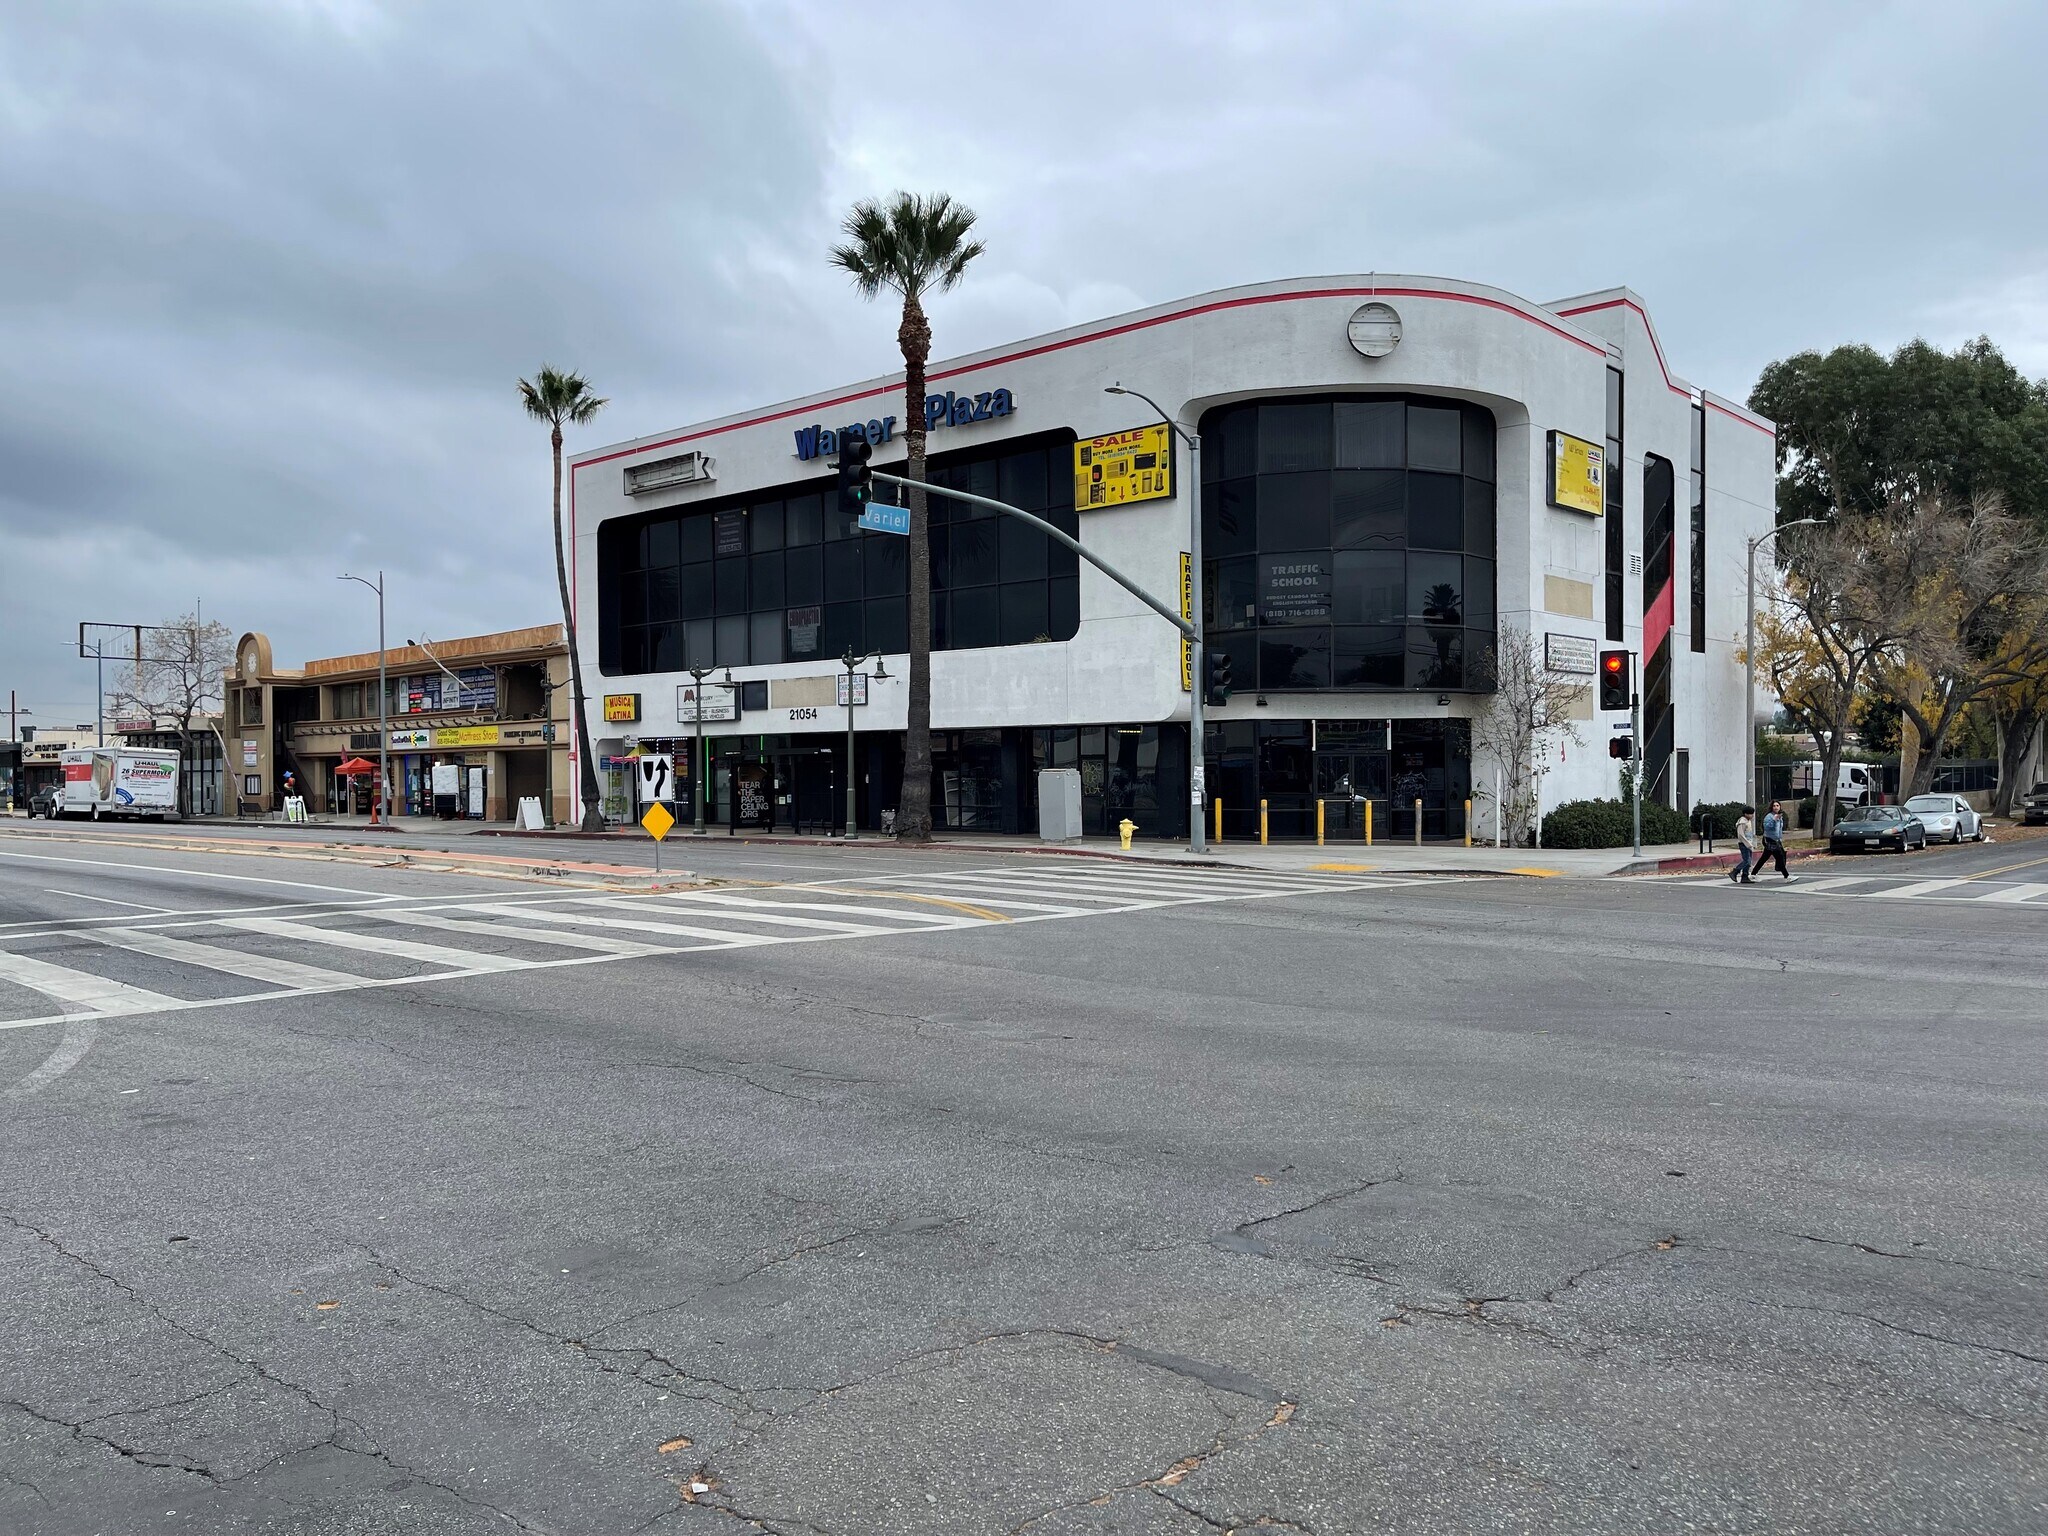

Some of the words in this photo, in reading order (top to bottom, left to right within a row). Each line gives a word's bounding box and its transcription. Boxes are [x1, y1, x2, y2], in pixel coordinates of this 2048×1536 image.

[926, 388, 1014, 431] Plaza
[1092, 430, 1144, 449] SALE
[865, 509, 906, 528] Variel
[1271, 564, 1319, 575] TRAFFIC
[1184, 555, 1192, 620] TRAFFIC
[1271, 577, 1319, 587] SCHOOL
[1265, 609, 1286, 618] (818)
[1288, 608, 1326, 616] 716-0188
[1184, 637, 1192, 681] HOOL
[609, 697, 631, 708] MUSICA
[608, 710, 631, 720] LATINA
[789, 708, 817, 720] 21054
[437, 729, 448, 737] Good
[459, 732, 481, 742] Mattress
[482, 729, 498, 740] Store
